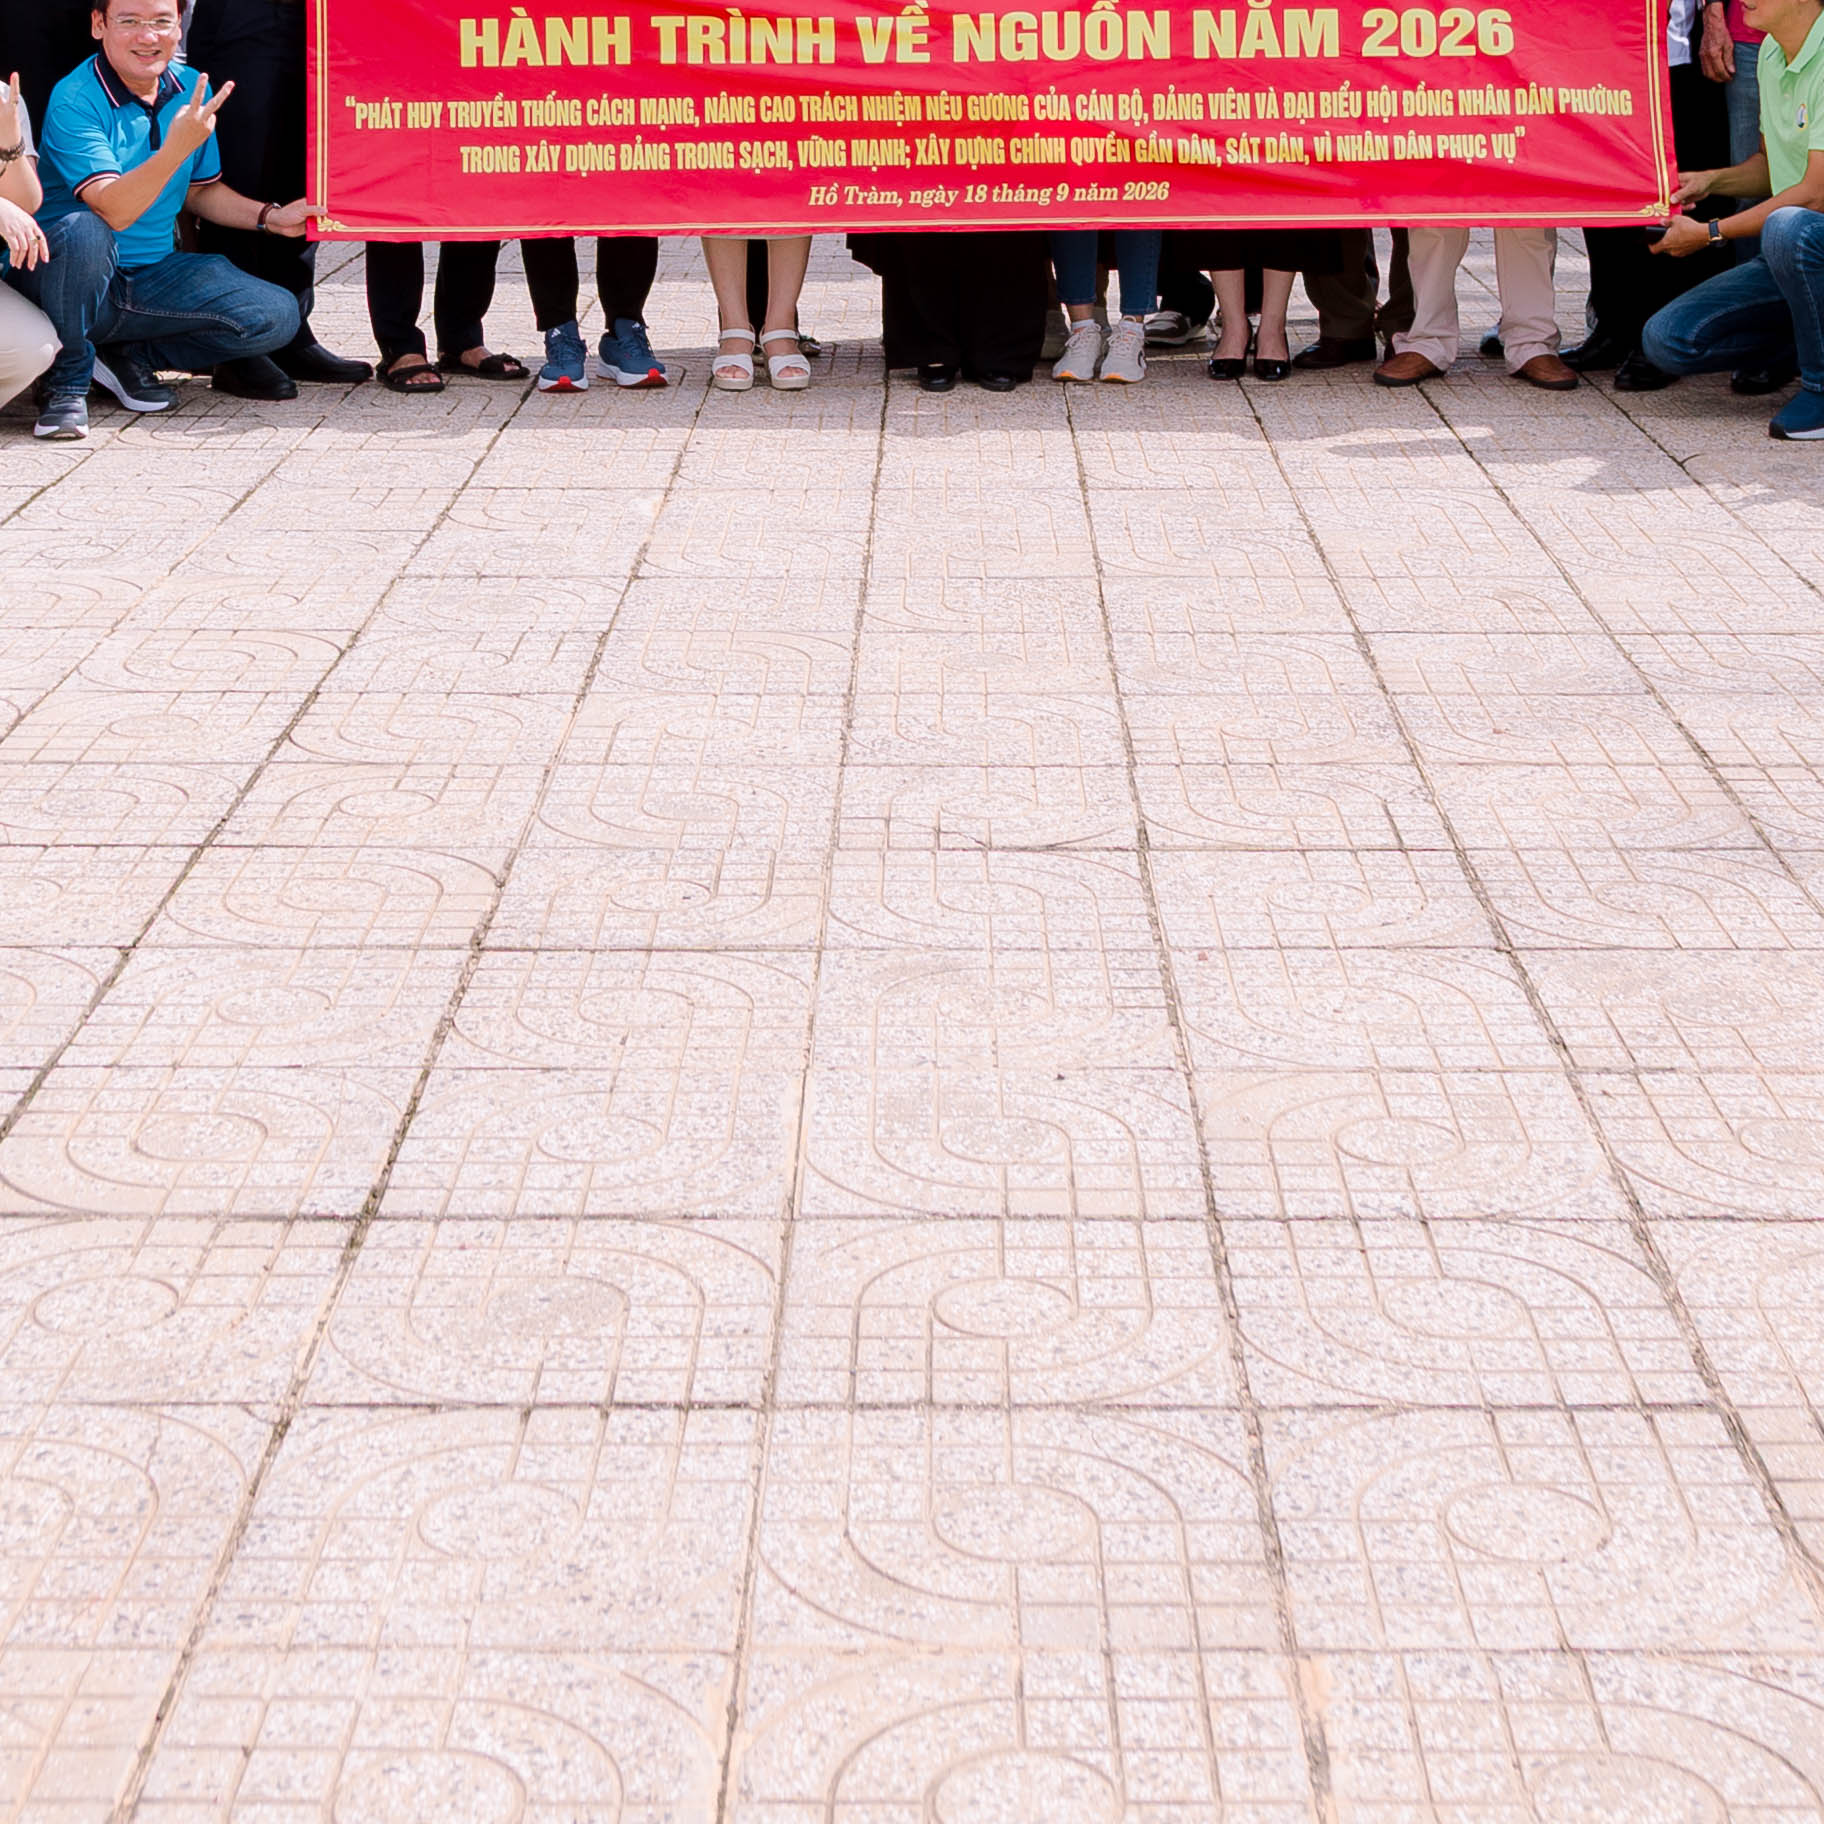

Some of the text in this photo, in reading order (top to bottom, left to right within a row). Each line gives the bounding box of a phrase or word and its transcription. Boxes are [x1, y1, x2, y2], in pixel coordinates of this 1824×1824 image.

[459, 6, 631, 68] HÀNH
[650, 7, 836, 66] TRÌNH
[1361, 6, 1515, 59] 2026
[406, 101, 444, 130] HUY
[446, 91, 518, 130] TRUYỀN
[521, 89, 583, 129] THỐNG
[586, 92, 636, 128] CÁCH
[639, 95, 700, 132] MẠNG,
[704, 90, 756, 125] NÂNG
[759, 94, 796, 124] CAO
[798, 89, 859, 123] TRÁCH
[861, 90, 922, 128] NHIỆM
[925, 89, 963, 122] NÊU
[966, 91, 1030, 122] GƯƠNG
[1033, 84, 1072, 122] CỦA
[1075, 87, 1115, 122] CÁN
[1117, 86, 1149, 128] BỘ,
[1152, 83, 1204, 122] ĐẢNG
[1207, 86, 1251, 121] VIÊN
[1254, 85, 1280, 121] VÀ
[1282, 90, 1316, 126] ĐẠI
[1319, 78, 1363, 120] BIỂU
[1366, 83, 1399, 124] HỘI
[1401, 79, 1455, 118] ĐỒNG
[1457, 83, 1512, 117] NHÂN
[1514, 80, 1555, 116] DÂN
[1557, 82, 1632, 117] PHƯỜNG
[459, 144, 521, 175] TRONG
[524, 138, 561, 174] XÂY
[565, 141, 617, 178] DỰNG
[619, 134, 671, 172] ĐẢNG
[674, 140, 735, 171] TRONG
[738, 139, 794, 175] SẠCH,
[796, 134, 847, 169] VỮNG
[850, 137, 911, 173] MẠNH;
[914, 132, 951, 166] XÂY
[954, 134, 1006, 171] DỰNG
[1009, 132, 1067, 165] CHÍNH
[1070, 130, 1131, 167] QUYỀN
[1134, 128, 1173, 164] GẦN
[1176, 132, 1223, 168] DÂN,
[1225, 131, 1261, 165] SÁT
[1264, 130, 1310, 166] DÂN,
[1312, 129, 1333, 163] VÌ
[1336, 129, 1390, 163] NHÂN
[1392, 129, 1433, 161] DÂN
[1436, 133, 1488, 165] PHỤC
[808, 180, 1170, 209] Hồ Tràm, ngày 18 tháng 9 năm 2026
